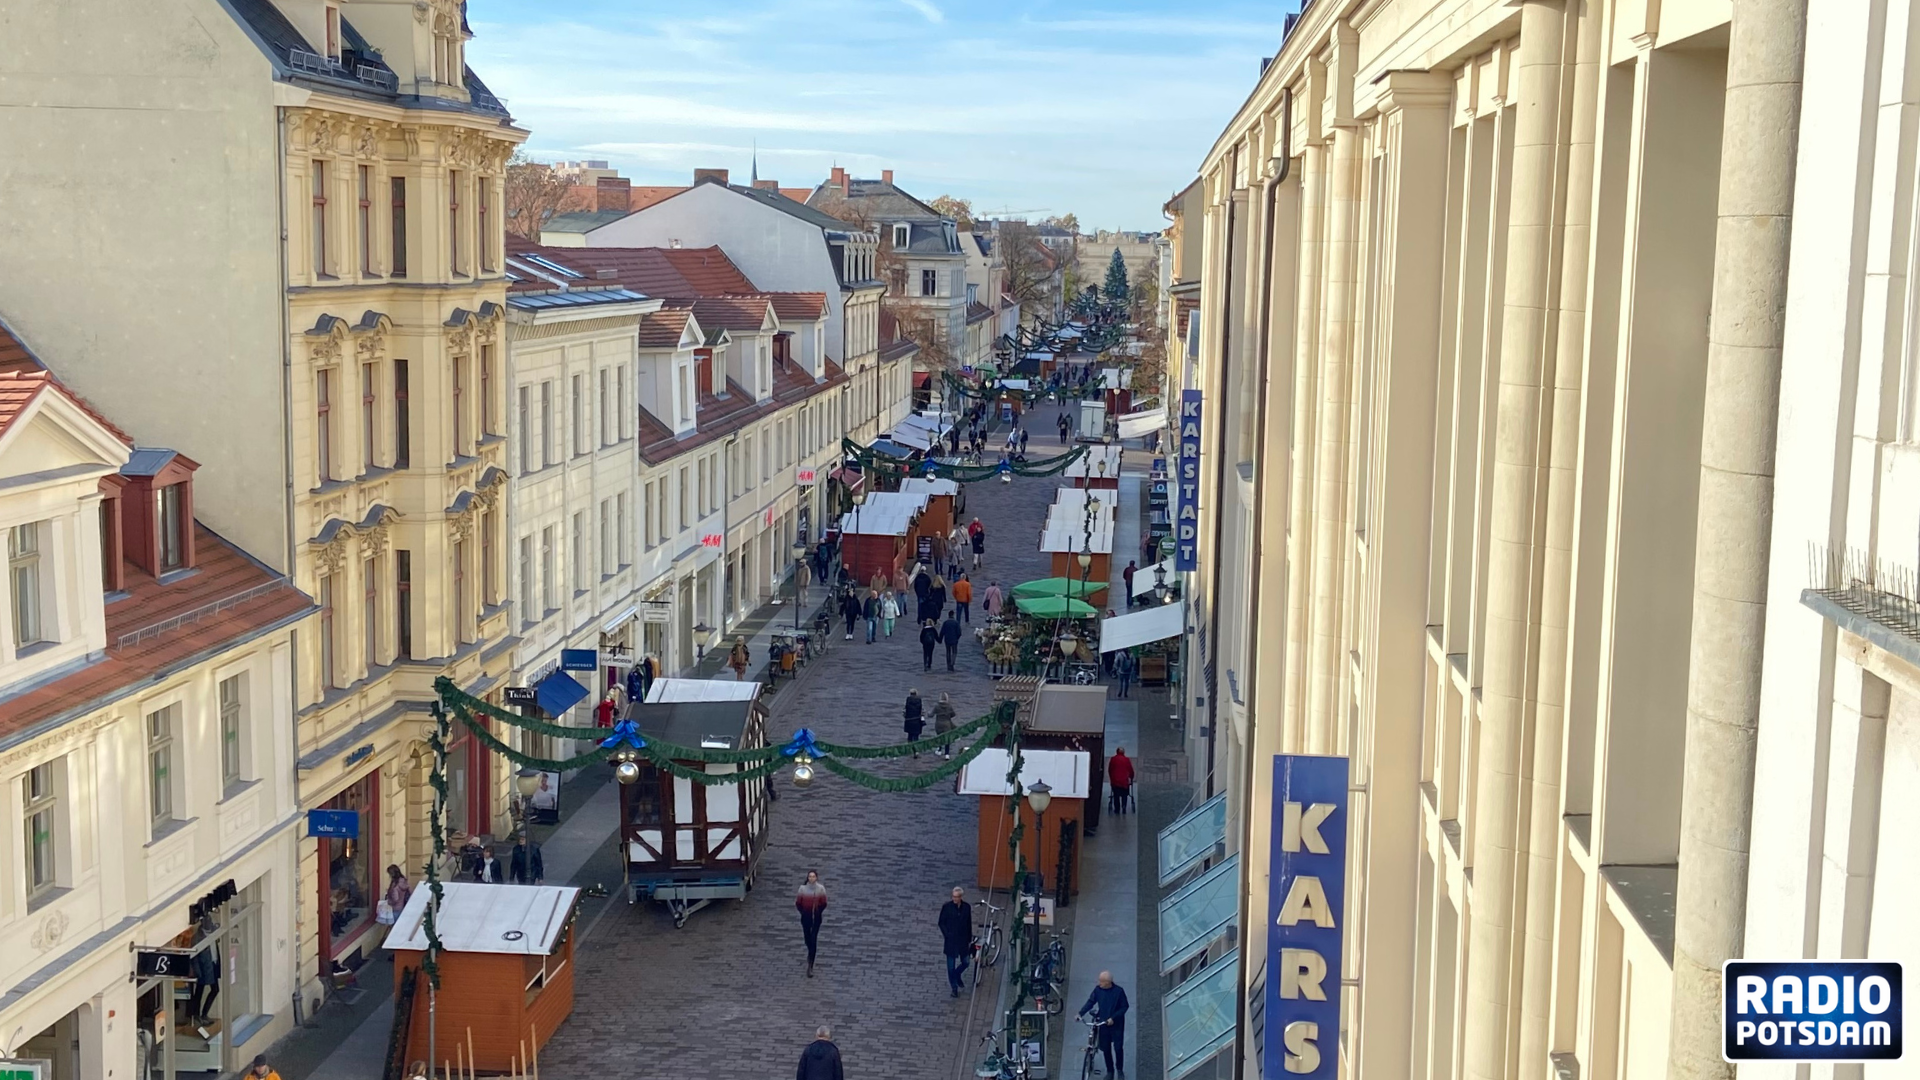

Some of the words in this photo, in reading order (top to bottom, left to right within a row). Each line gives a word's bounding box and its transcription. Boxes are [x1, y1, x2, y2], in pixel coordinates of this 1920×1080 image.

[1180, 402, 1200, 560] KARSTADT
[508, 690, 535, 699] Think!
[1277, 801, 1336, 1074] KARS
